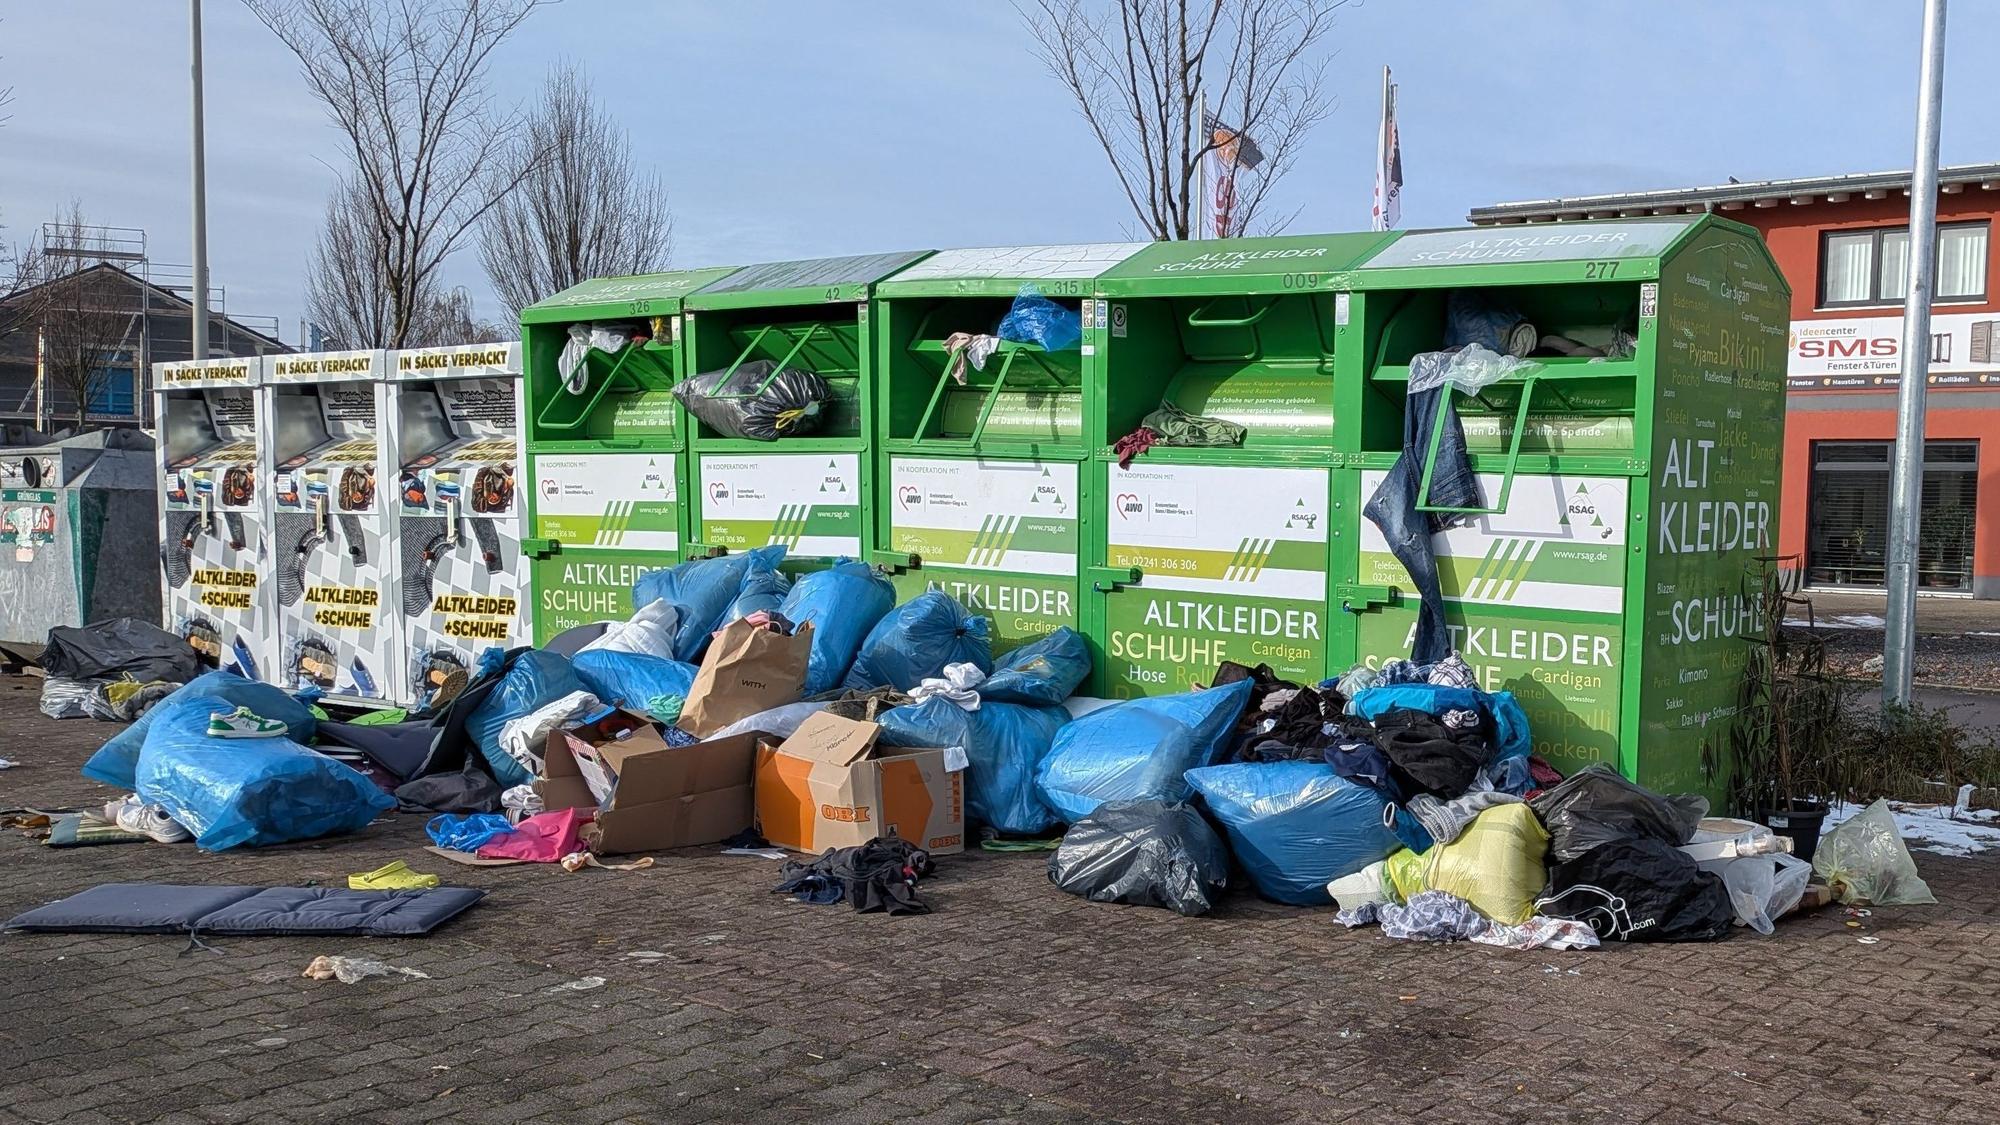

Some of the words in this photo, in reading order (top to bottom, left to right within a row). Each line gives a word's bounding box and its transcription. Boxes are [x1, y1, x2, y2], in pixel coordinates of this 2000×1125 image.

[1457, 232, 1629, 250] ALTKLEIDER
[1191, 248, 1328, 262] ALTKLEIDER
[1411, 247, 1530, 263] SCHUHE
[1153, 260, 1249, 272] SCHUHE
[1585, 261, 1620, 279] 277
[1054, 281, 1078, 294] 315
[1283, 273, 1318, 289] 009
[825, 287, 841, 300] 42
[1721, 282, 1750, 306] Cardigan
[630, 301, 650, 315] 326
[1800, 327, 1857, 336] Ideencenter
[1689, 342, 1718, 368] Pyjama
[1720, 329, 1766, 371] Bikini
[1799, 338, 1897, 358] SMS
[276, 362, 286, 375] IN
[320, 358, 371, 372] VERPACKT
[400, 357, 411, 370] IN
[451, 351, 507, 367] VERPACKT
[164, 370, 173, 381] IN
[203, 366, 248, 379] VERPACKT
[1487, 426, 1514, 436] Dank
[1536, 427, 1558, 437] Ihre
[1718, 422, 1748, 448] Jacke
[905, 467, 948, 475] KOOPERATION
[1661, 438, 1715, 488] ALT
[715, 490, 729, 499] AWO
[1037, 486, 1056, 494] RSAG
[905, 494, 922, 504] AWO
[817, 511, 850, 520] www.rsag.de
[1124, 502, 1143, 513] AWO
[1568, 504, 1595, 515] RSAG
[1292, 513, 1309, 521] RSAG
[1027, 523, 1066, 534] www.rsag.de
[1659, 501, 1771, 555] KLEIDER
[726, 536, 736, 544] 306
[736, 536, 746, 544] 306
[932, 546, 943, 555] 306
[1552, 550, 1608, 563] www.rsag.de
[1116, 555, 1131, 566] Tel.
[1132, 556, 1158, 568] 02241
[1161, 558, 1178, 570] 306
[1180, 558, 1197, 571] 306
[192, 570, 257, 588] ALTKLEIDER
[562, 563, 673, 587] ALTKLEI
[1372, 571, 1398, 583] 02241
[1657, 583, 1676, 594] Blazer
[201, 592, 251, 608] +SCHUHE
[305, 588, 378, 606] ALTKLEIDER
[543, 589, 617, 614] SCHUHE
[434, 596, 516, 616] ALTKLEIDER
[315, 610, 371, 628] +SCHUHE
[555, 615, 580, 629] Hose
[1014, 617, 1062, 636] Cardiga
[1144, 599, 1320, 640] ALTKLEIDER
[445, 620, 508, 639] +SCHUHE
[1403, 622, 1614, 668] ATKLEIDER
[1660, 634, 1670, 645] BH
[1112, 630, 1227, 667] SCHUHE
[1252, 640, 1311, 662] Cardigan
[1721, 648, 1747, 670] Kleid
[1129, 664, 1167, 684] Hose
[1531, 667, 1602, 691] Cardigan
[1679, 667, 1709, 684] Kimono
[742, 680, 767, 690] WITH
[1665, 698, 1684, 710] Sakko
[1682, 714, 1694, 727] Das
[821, 803, 871, 823] OBI
[929, 834, 961, 849] OBI
[1632, 917, 1656, 931] .com
